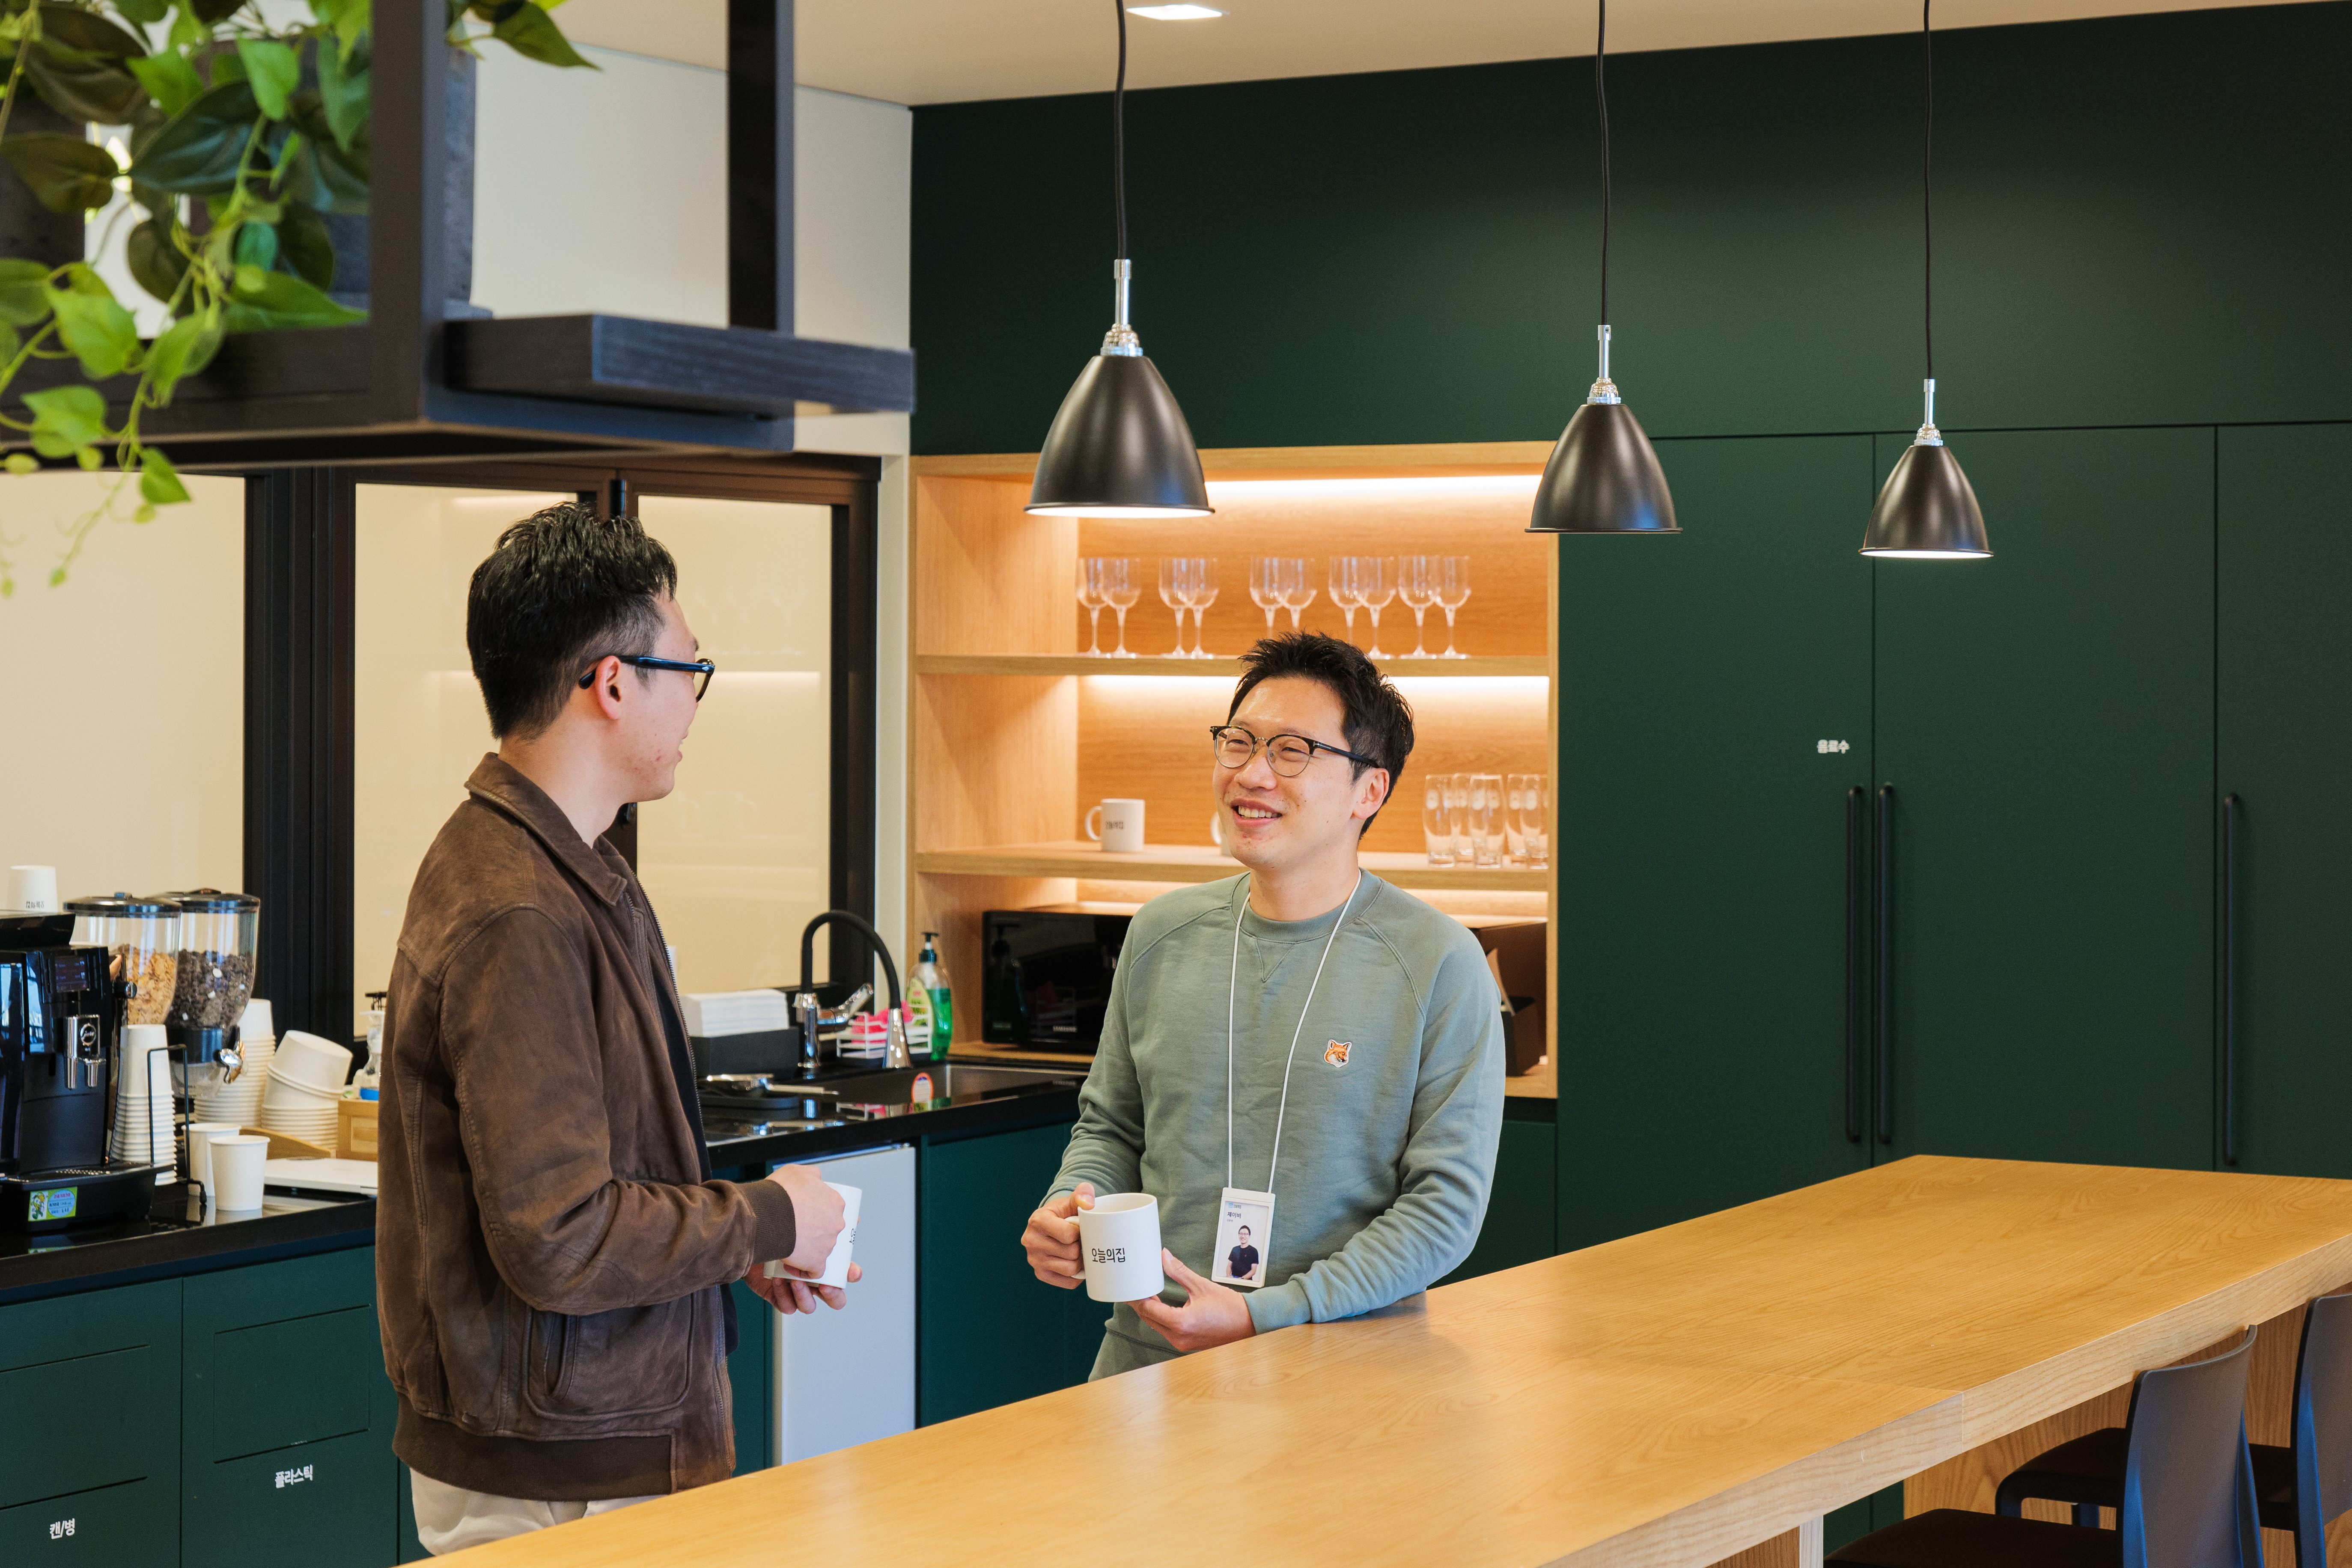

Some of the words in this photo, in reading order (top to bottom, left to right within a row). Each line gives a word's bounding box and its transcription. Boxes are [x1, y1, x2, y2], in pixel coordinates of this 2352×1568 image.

[1092, 1247, 1125, 1263] 오늘의집
[275, 1464, 313, 1488] 플라스틱
[50, 1518, 75, 1539] 캔/병
